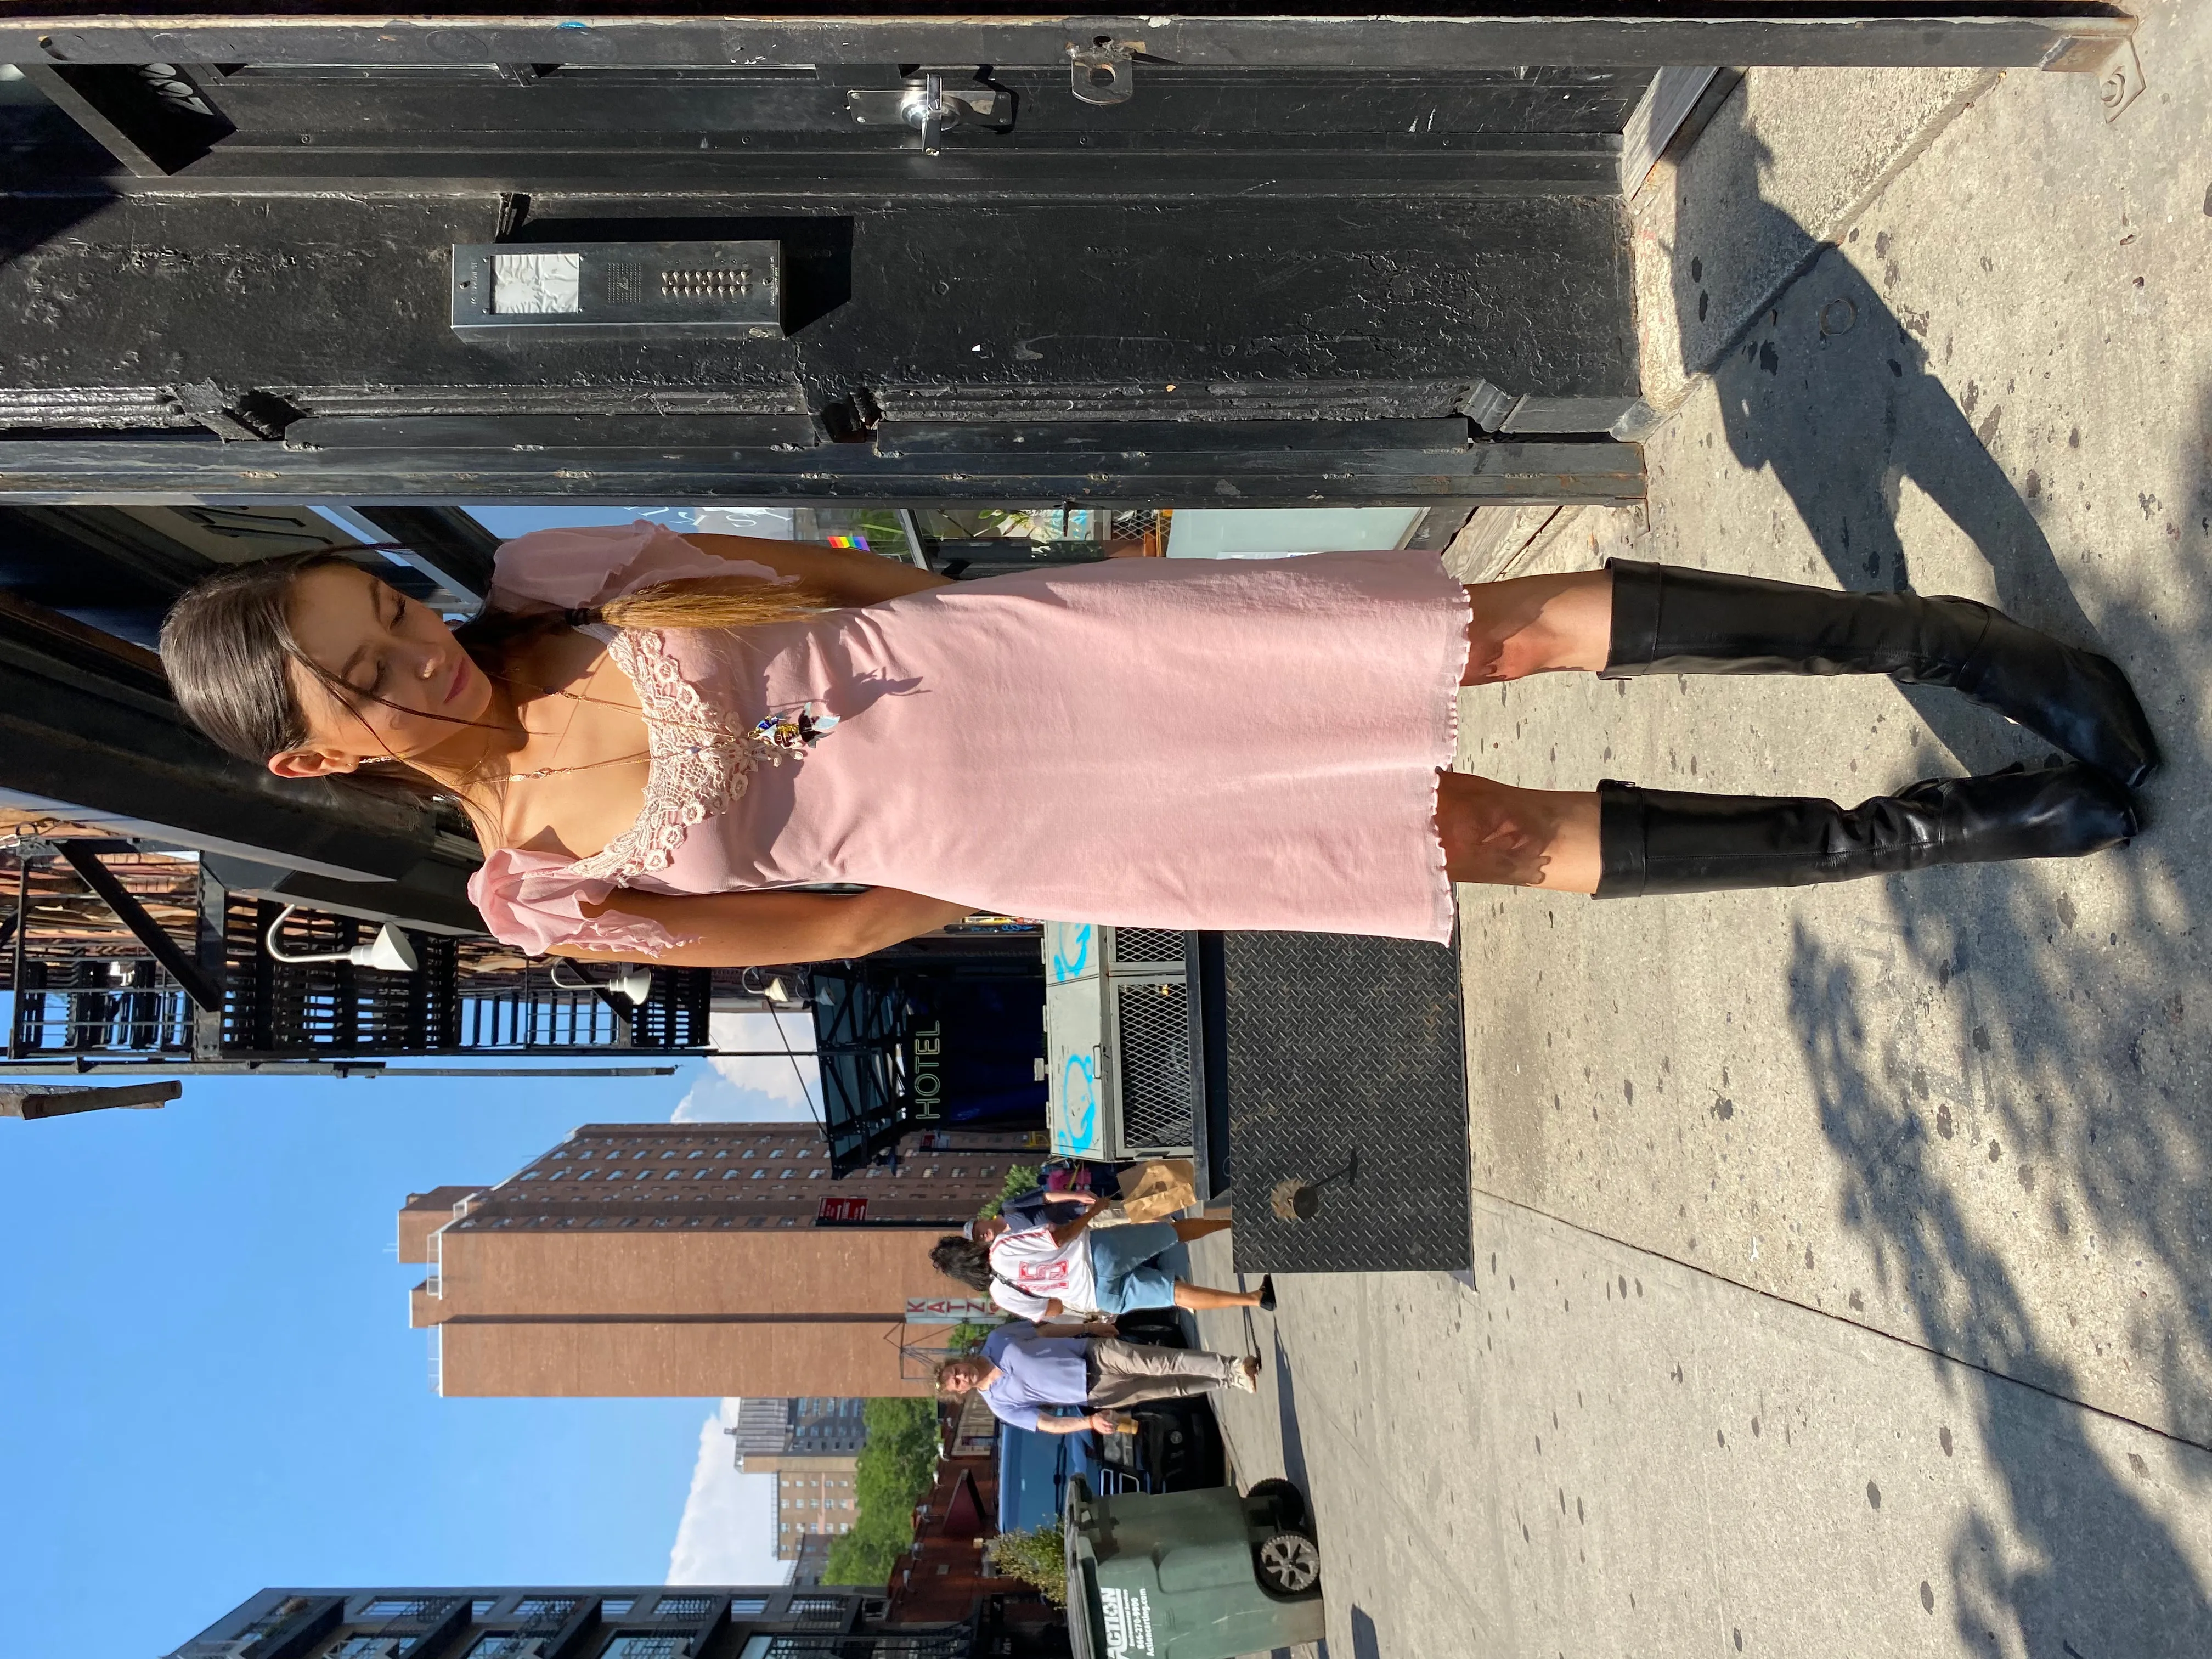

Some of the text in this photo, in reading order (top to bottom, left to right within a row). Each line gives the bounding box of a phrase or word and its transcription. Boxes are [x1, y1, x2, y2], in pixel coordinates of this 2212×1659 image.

[165, 506, 334, 545] 17
[914, 1020, 941, 1119] HOTEL
[1018, 1260, 1069, 1293] 15
[1100, 1587, 1130, 1659] ACTION
[1139, 1588, 1155, 1656] Actioncarting.com
